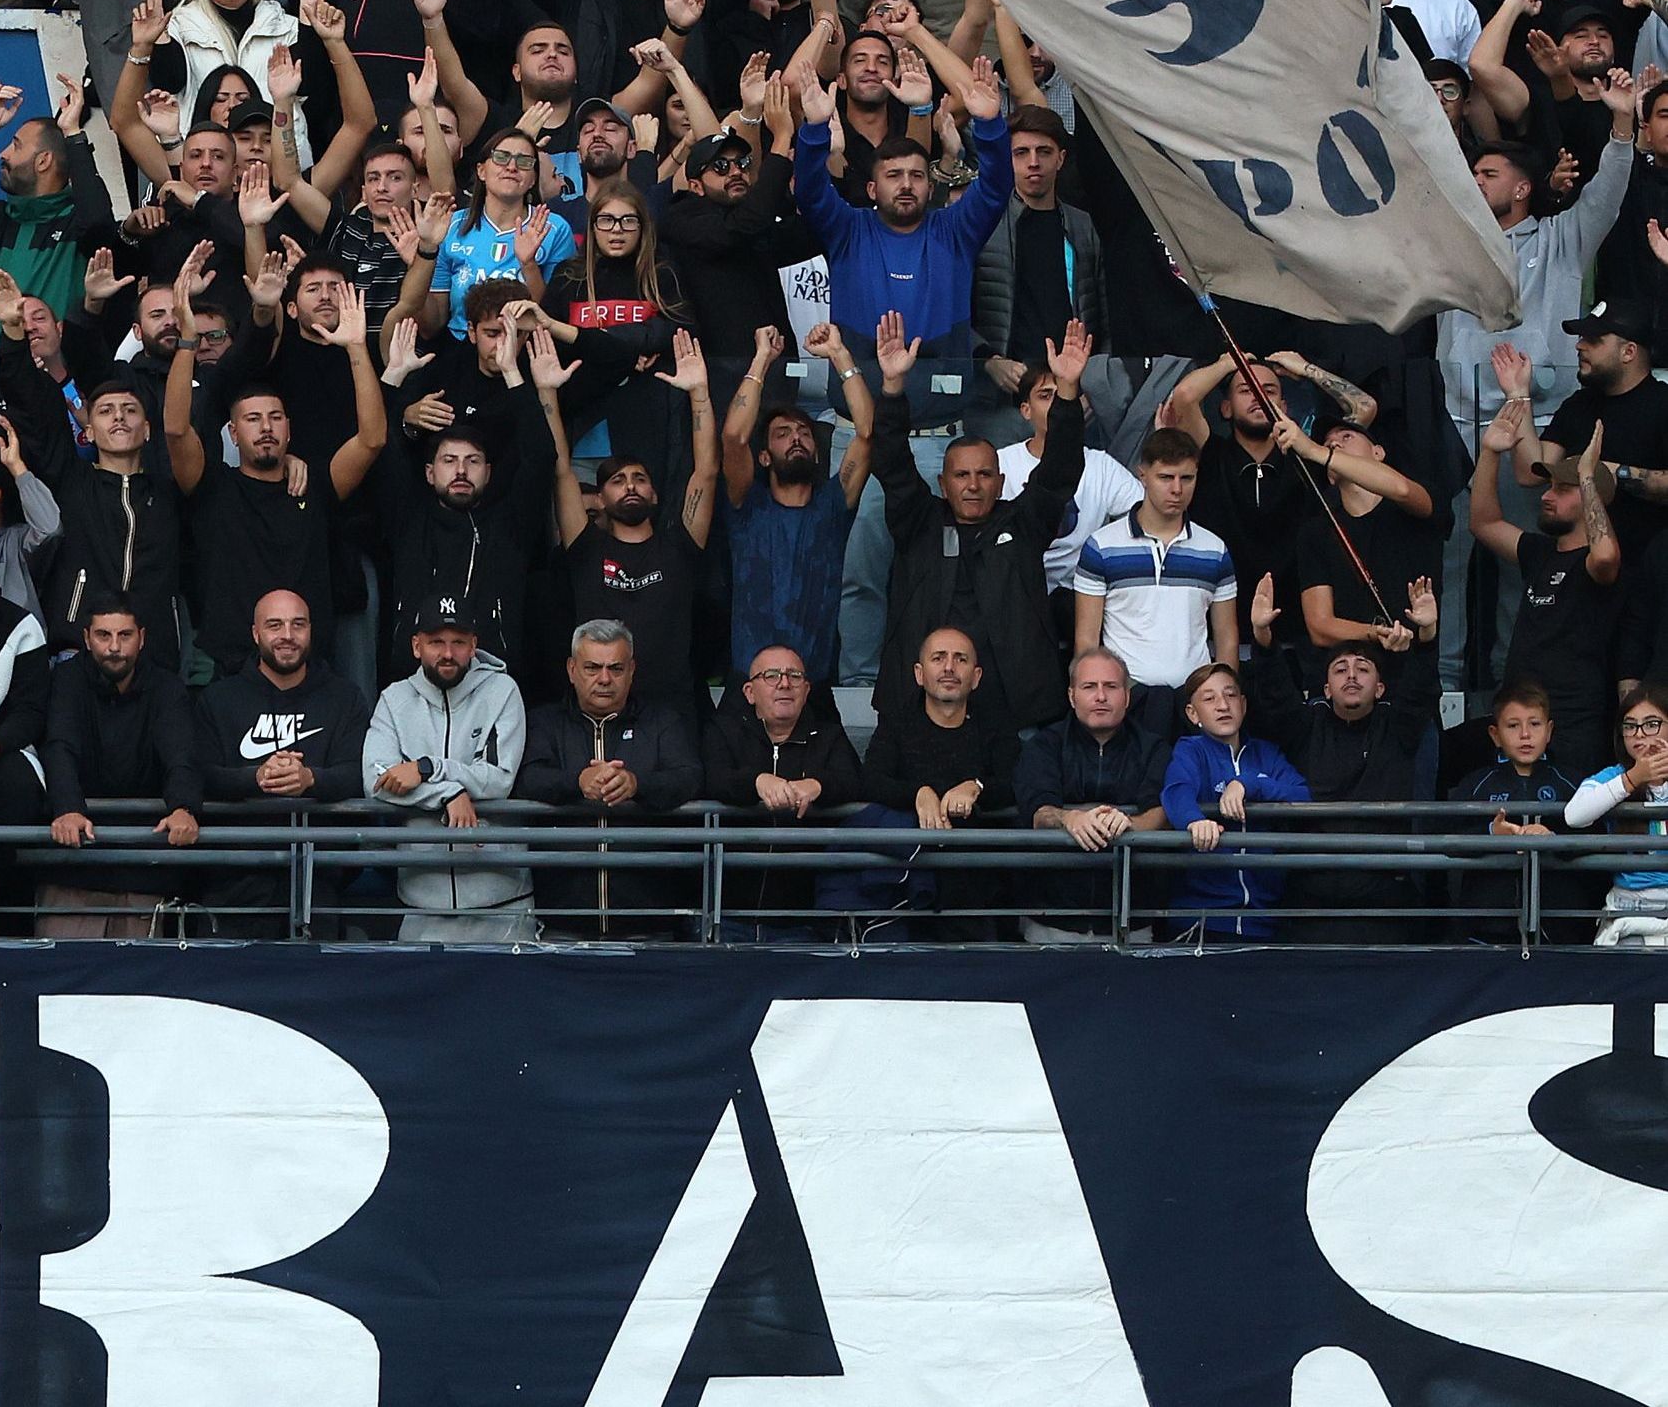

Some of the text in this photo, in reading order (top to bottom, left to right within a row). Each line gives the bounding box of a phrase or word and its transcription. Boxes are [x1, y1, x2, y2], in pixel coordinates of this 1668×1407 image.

[580, 303, 645, 324] FREE
[439, 597, 456, 614] NY
[252, 713, 305, 741] NIKE
